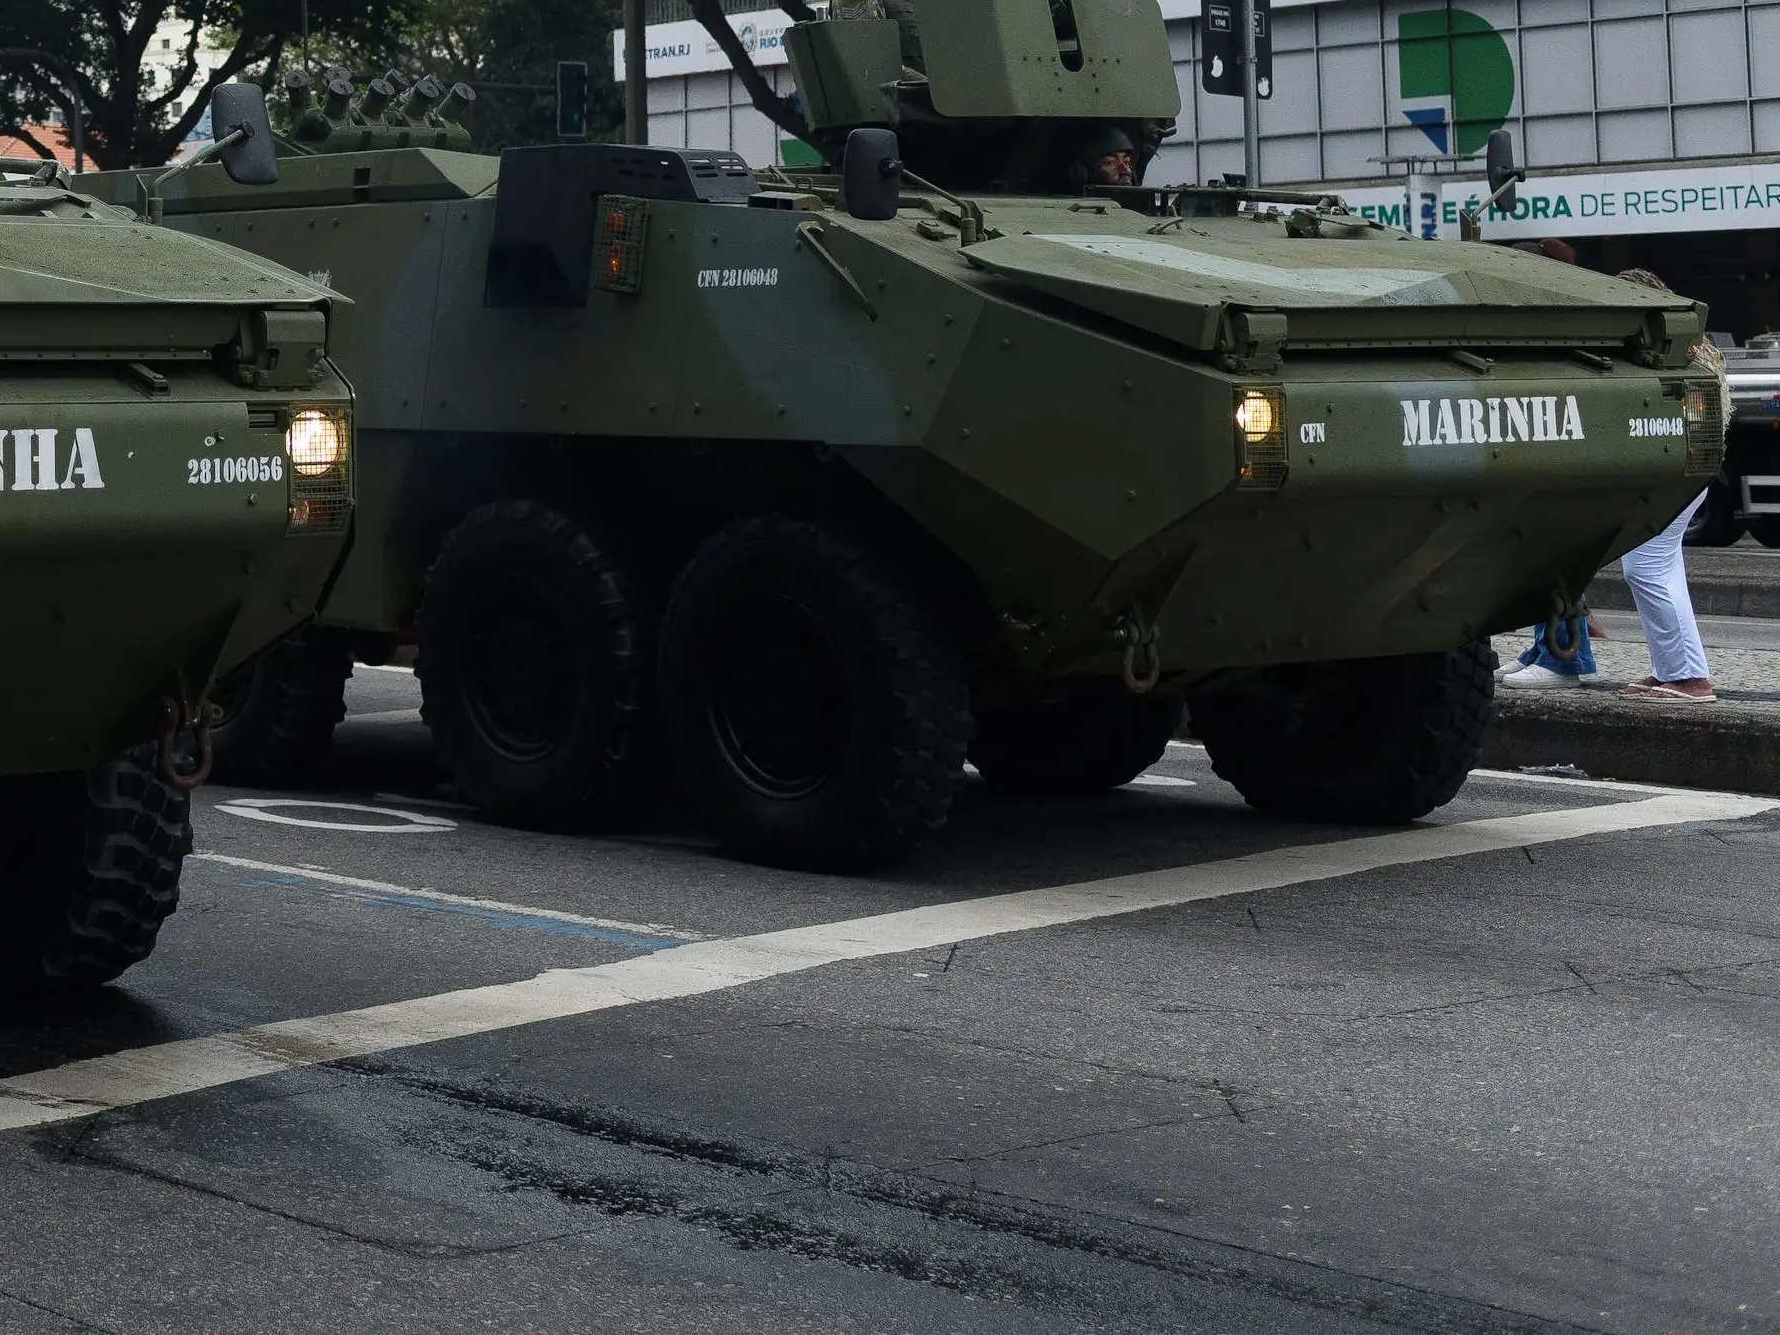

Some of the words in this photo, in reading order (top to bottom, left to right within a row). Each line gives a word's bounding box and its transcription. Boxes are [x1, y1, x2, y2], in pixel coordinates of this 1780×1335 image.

[645, 44, 691, 61] TRAN.RJ
[1581, 193, 1616, 217] DE
[1624, 183, 1780, 216] RESPEITAR
[697, 269, 720, 287] CFN
[721, 267, 778, 286] 28106048
[1300, 422, 1325, 444] CFN
[1400, 395, 1585, 446] MARINHA
[1628, 417, 1683, 437] 28106048
[186, 455, 283, 485] 28106056
